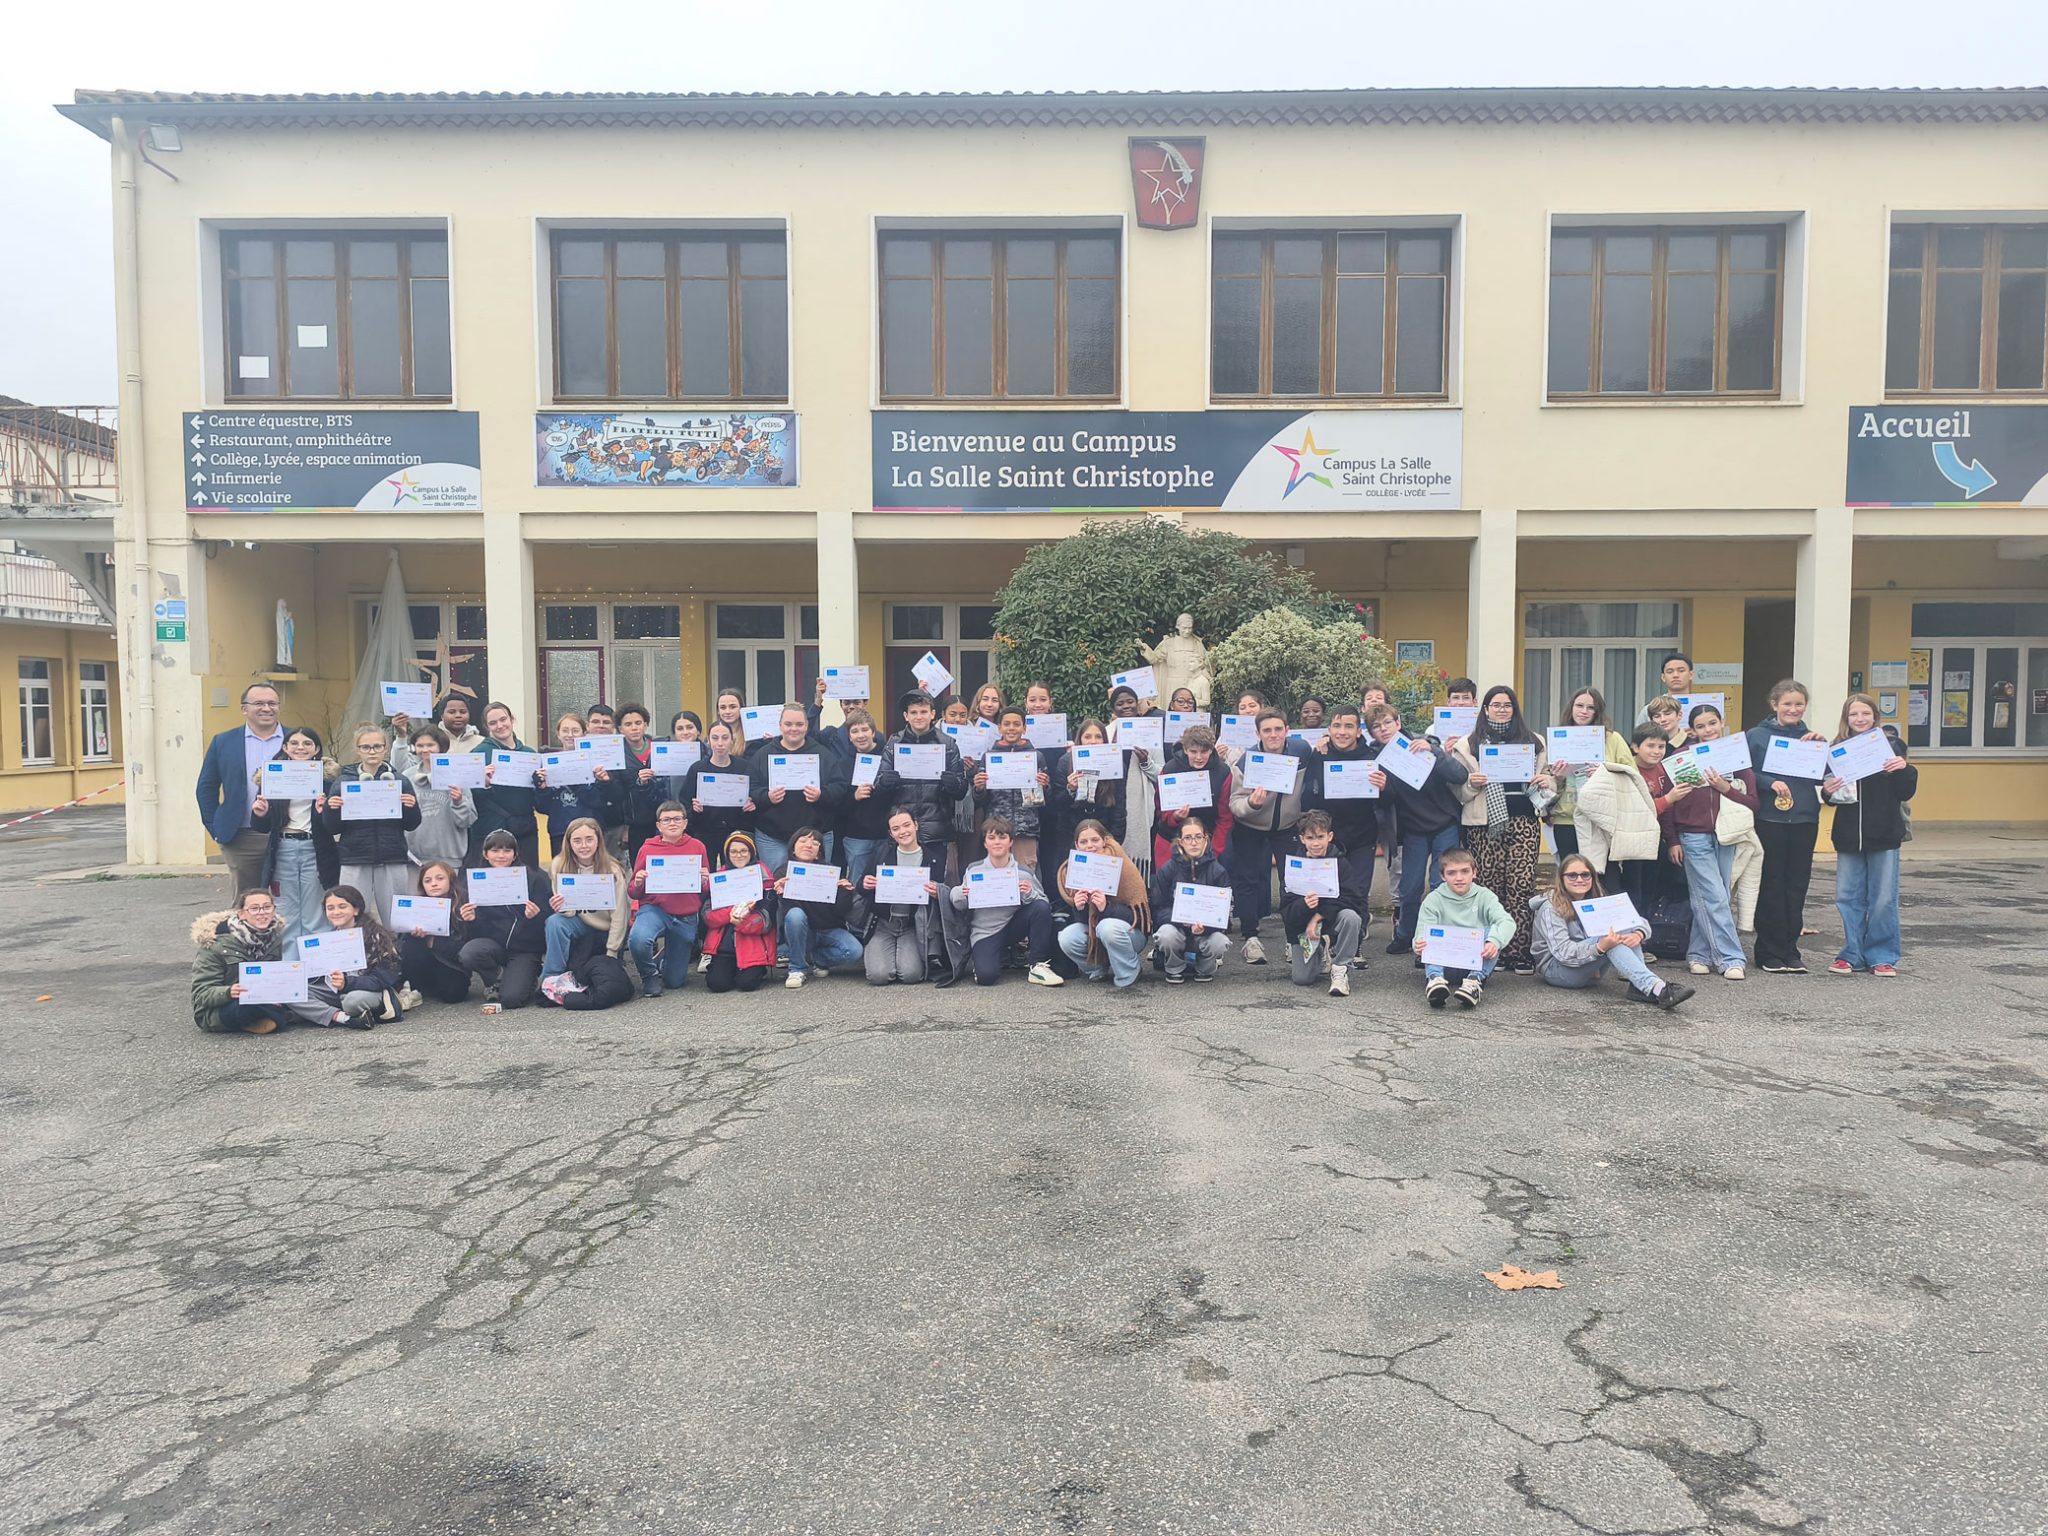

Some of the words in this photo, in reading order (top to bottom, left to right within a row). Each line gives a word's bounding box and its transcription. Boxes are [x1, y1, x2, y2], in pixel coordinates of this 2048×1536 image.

[209, 415, 255, 427] Centre
[259, 415, 323, 429] équestre,
[326, 415, 352, 427] BTS
[1858, 411, 1971, 438] Accueil
[613, 425, 674, 437] FRATELLI
[678, 429, 719, 439] TUTTI
[210, 435, 293, 448] Restaurant,
[295, 434, 392, 449] amphithéâtre
[891, 430, 1025, 453] Bienvenue
[1032, 434, 1065, 453] au
[1071, 430, 1177, 458] Campus
[210, 453, 262, 467] Collège,
[264, 453, 304, 467] Lycée,
[306, 456, 351, 467] espace
[353, 453, 422, 465] animation
[1323, 458, 1376, 473] Campus
[1381, 457, 1396, 470] La
[1400, 457, 1432, 470] Salle
[210, 473, 282, 485] Infirmerie
[891, 466, 922, 488] La
[930, 465, 991, 488] Salle
[998, 465, 1066, 488] Saint
[1072, 465, 1214, 493] Christophe
[1343, 472, 1375, 485] Saint
[1380, 472, 1452, 488] Christophe
[412, 486, 439, 494] Campus
[1366, 489, 1399, 497] COLLÈGE
[1404, 489, 1426, 497] LYCÉE
[211, 492, 234, 504] Vie
[236, 492, 292, 504] scolaire
[441, 494, 477, 502] Christophe
